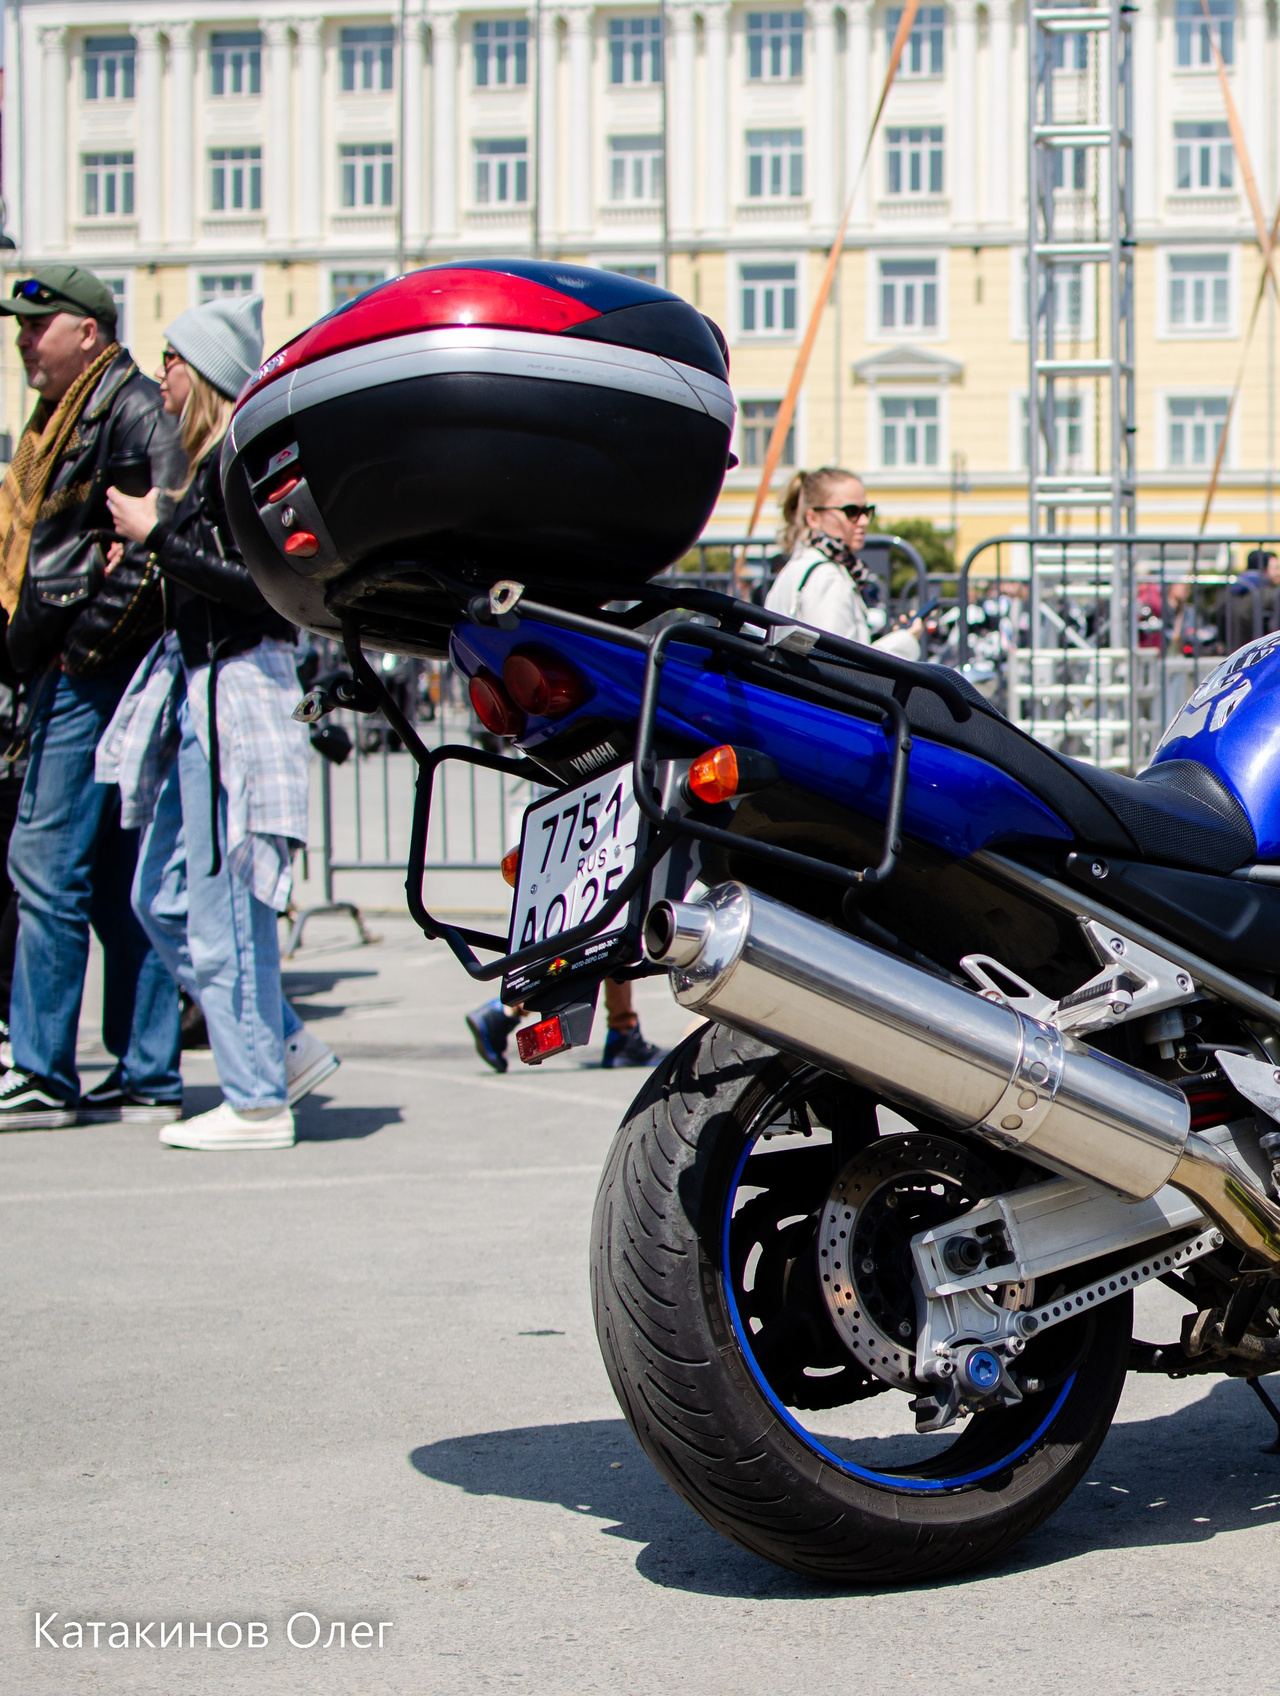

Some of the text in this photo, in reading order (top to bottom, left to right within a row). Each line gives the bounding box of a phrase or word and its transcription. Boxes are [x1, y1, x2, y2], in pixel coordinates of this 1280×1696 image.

[570, 742, 619, 776] YAMAHA
[540, 782, 624, 874] 7751
[577, 848, 608, 877] RUS
